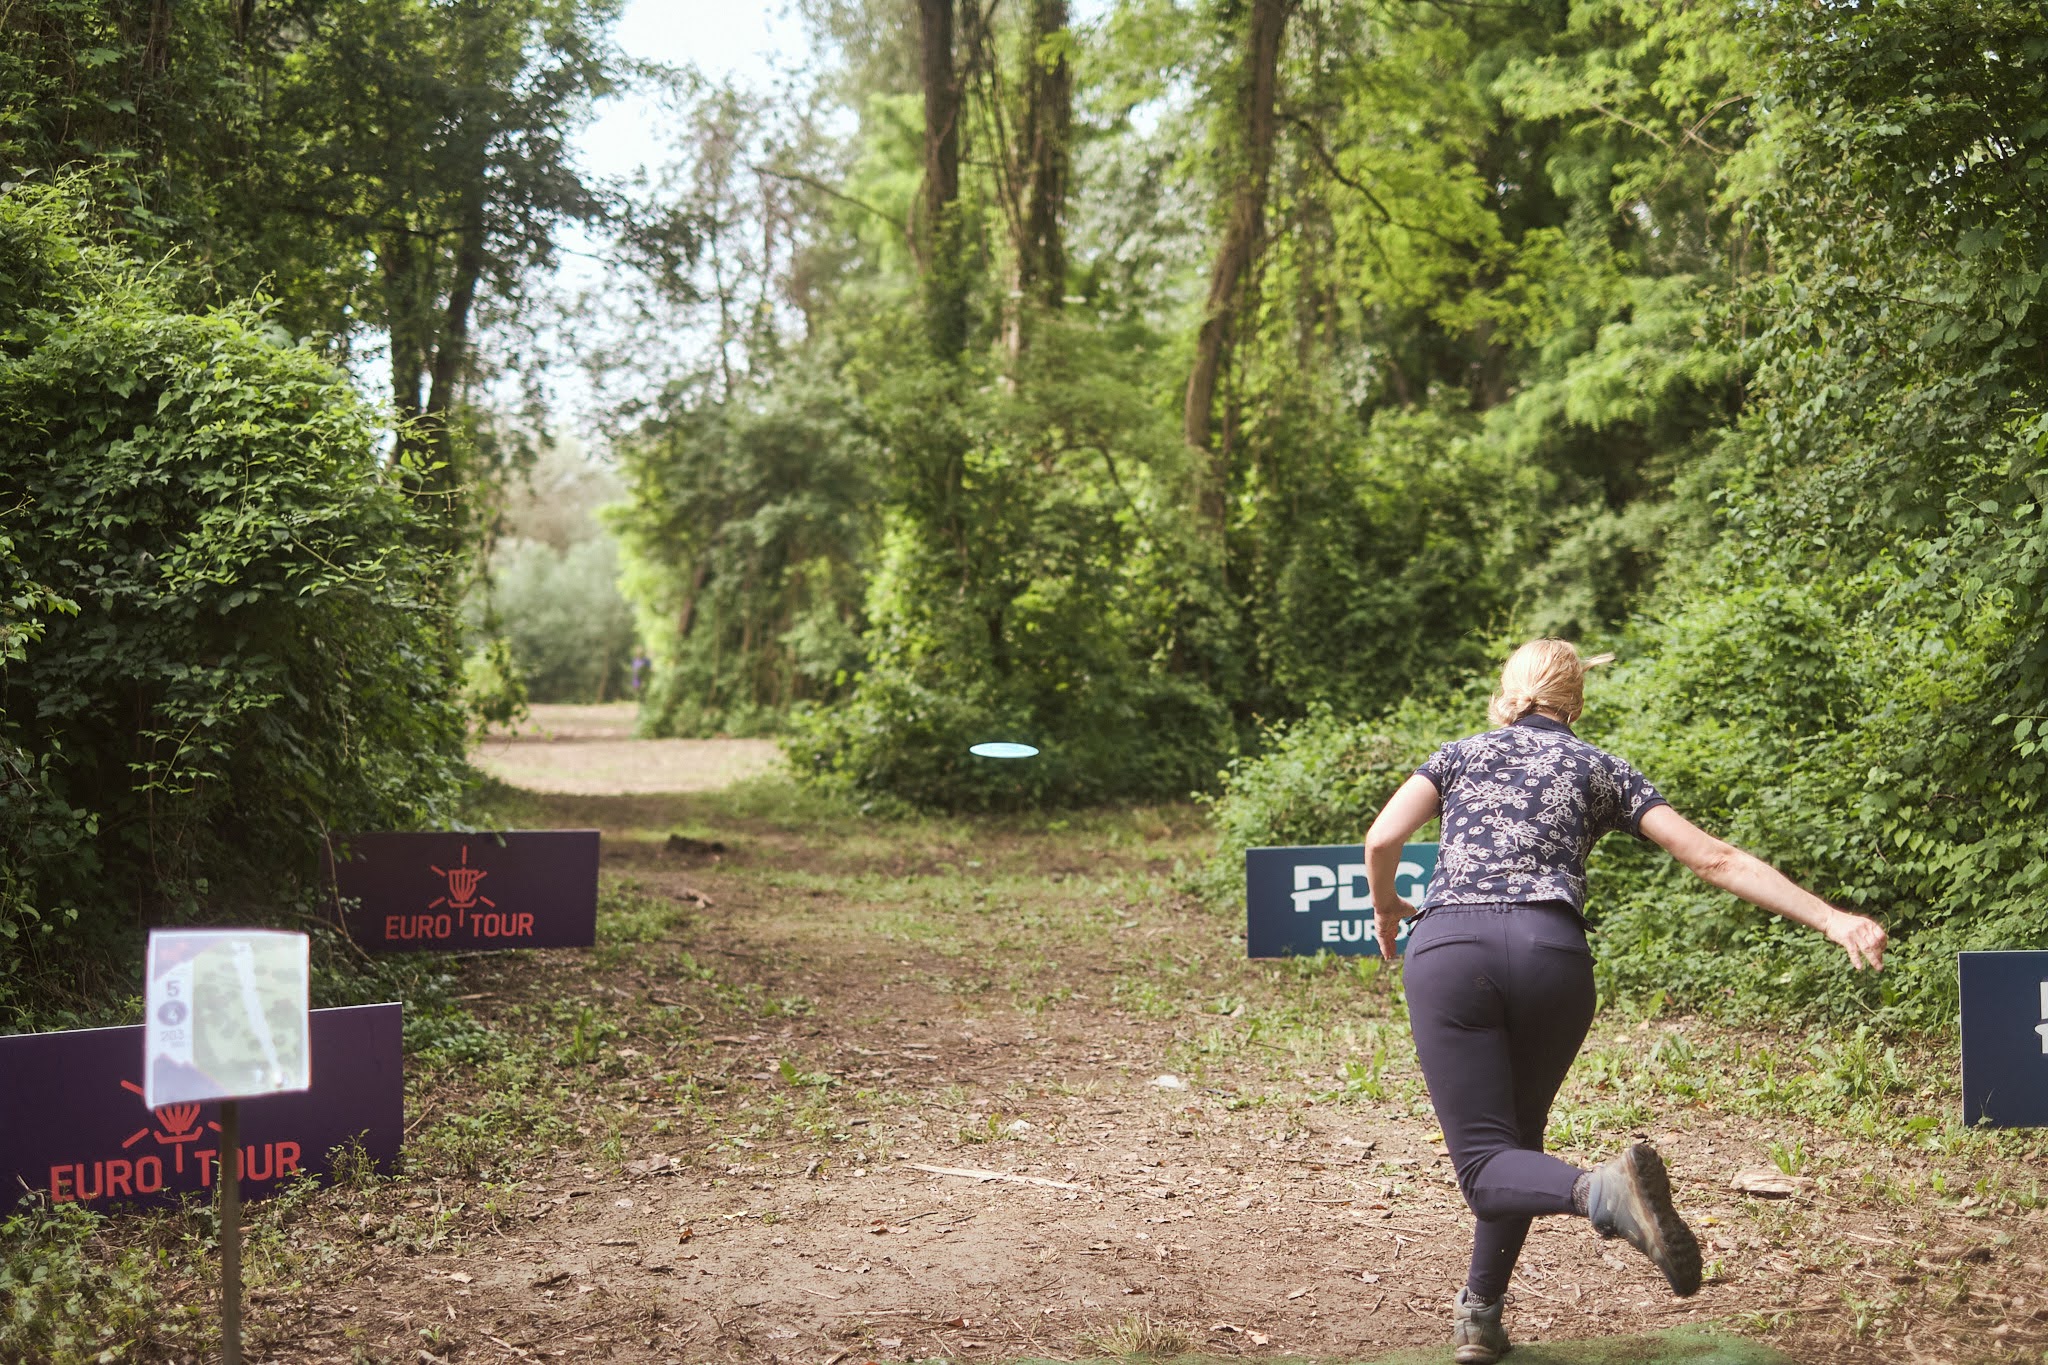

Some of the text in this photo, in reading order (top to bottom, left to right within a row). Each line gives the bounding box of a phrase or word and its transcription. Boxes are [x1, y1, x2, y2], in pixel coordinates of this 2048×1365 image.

[385, 913, 534, 939] EURO TOUR
[166, 980, 180, 998] 5
[50, 1156, 163, 1202] EURO
